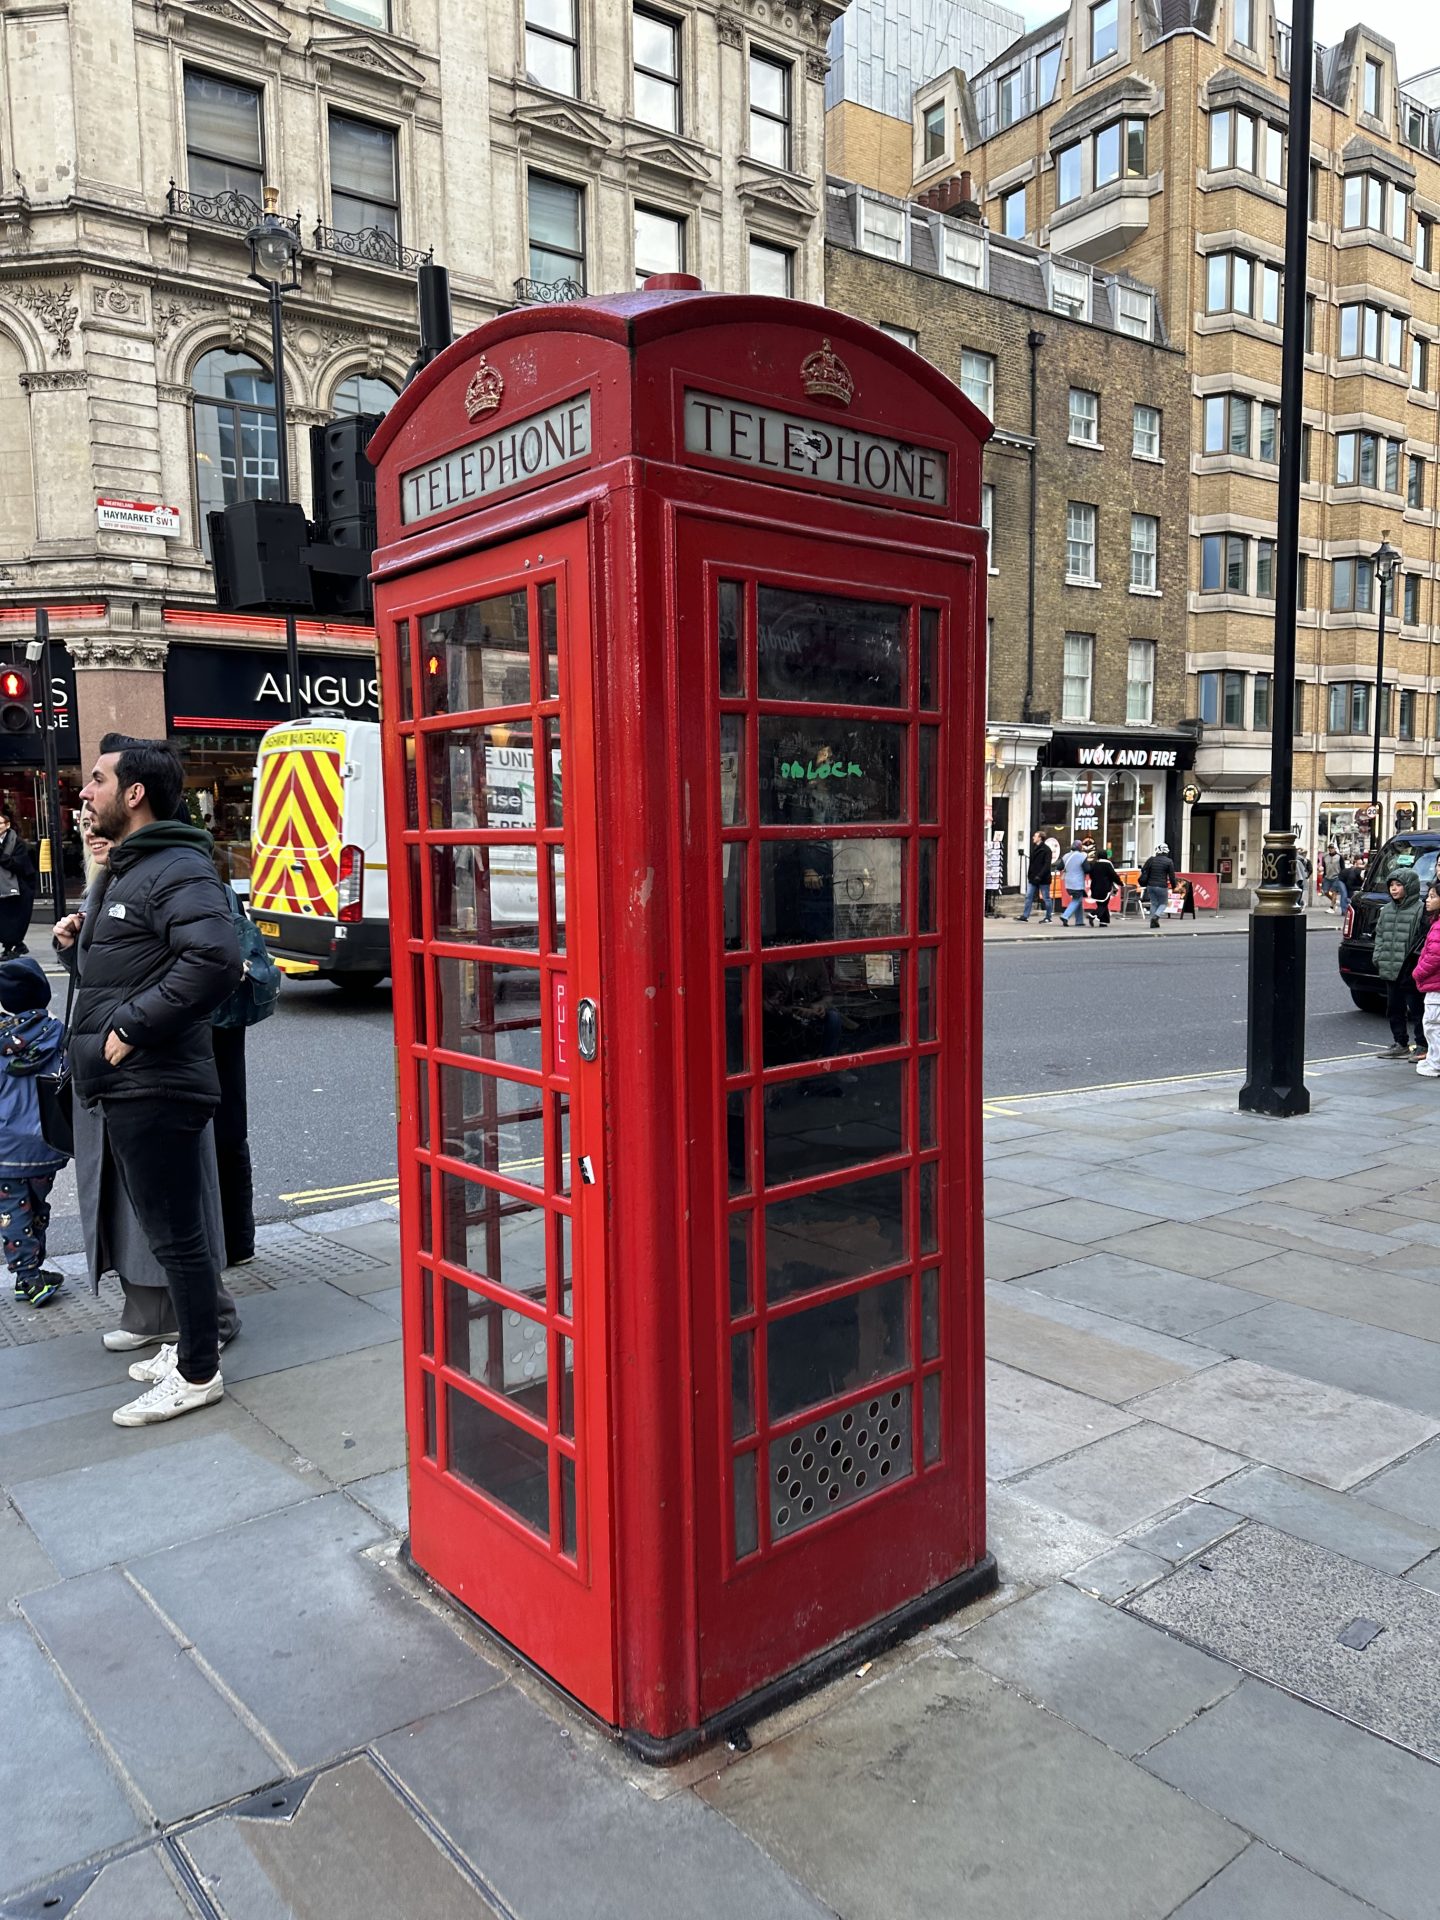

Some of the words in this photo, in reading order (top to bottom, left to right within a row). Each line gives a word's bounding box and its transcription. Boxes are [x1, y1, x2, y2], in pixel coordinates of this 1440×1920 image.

[692, 400, 937, 500] TELEPHONE
[408, 404, 587, 516] TELEPHONE
[103, 500, 134, 508] THEATRELAND
[103, 509, 154, 523] HAYMARKET
[156, 517, 173, 526] SW1
[254, 672, 380, 708] ANGUS
[1078, 743, 1114, 766] WOK
[1115, 749, 1147, 766] AND
[1149, 750, 1177, 767] FIRE
[1074, 792, 1102, 807] WOK
[1078, 807, 1096, 817] AND
[1074, 817, 1099, 831] FIRE
[1194, 884, 1210, 901] FIRE
[557, 984, 566, 1063] PULL
